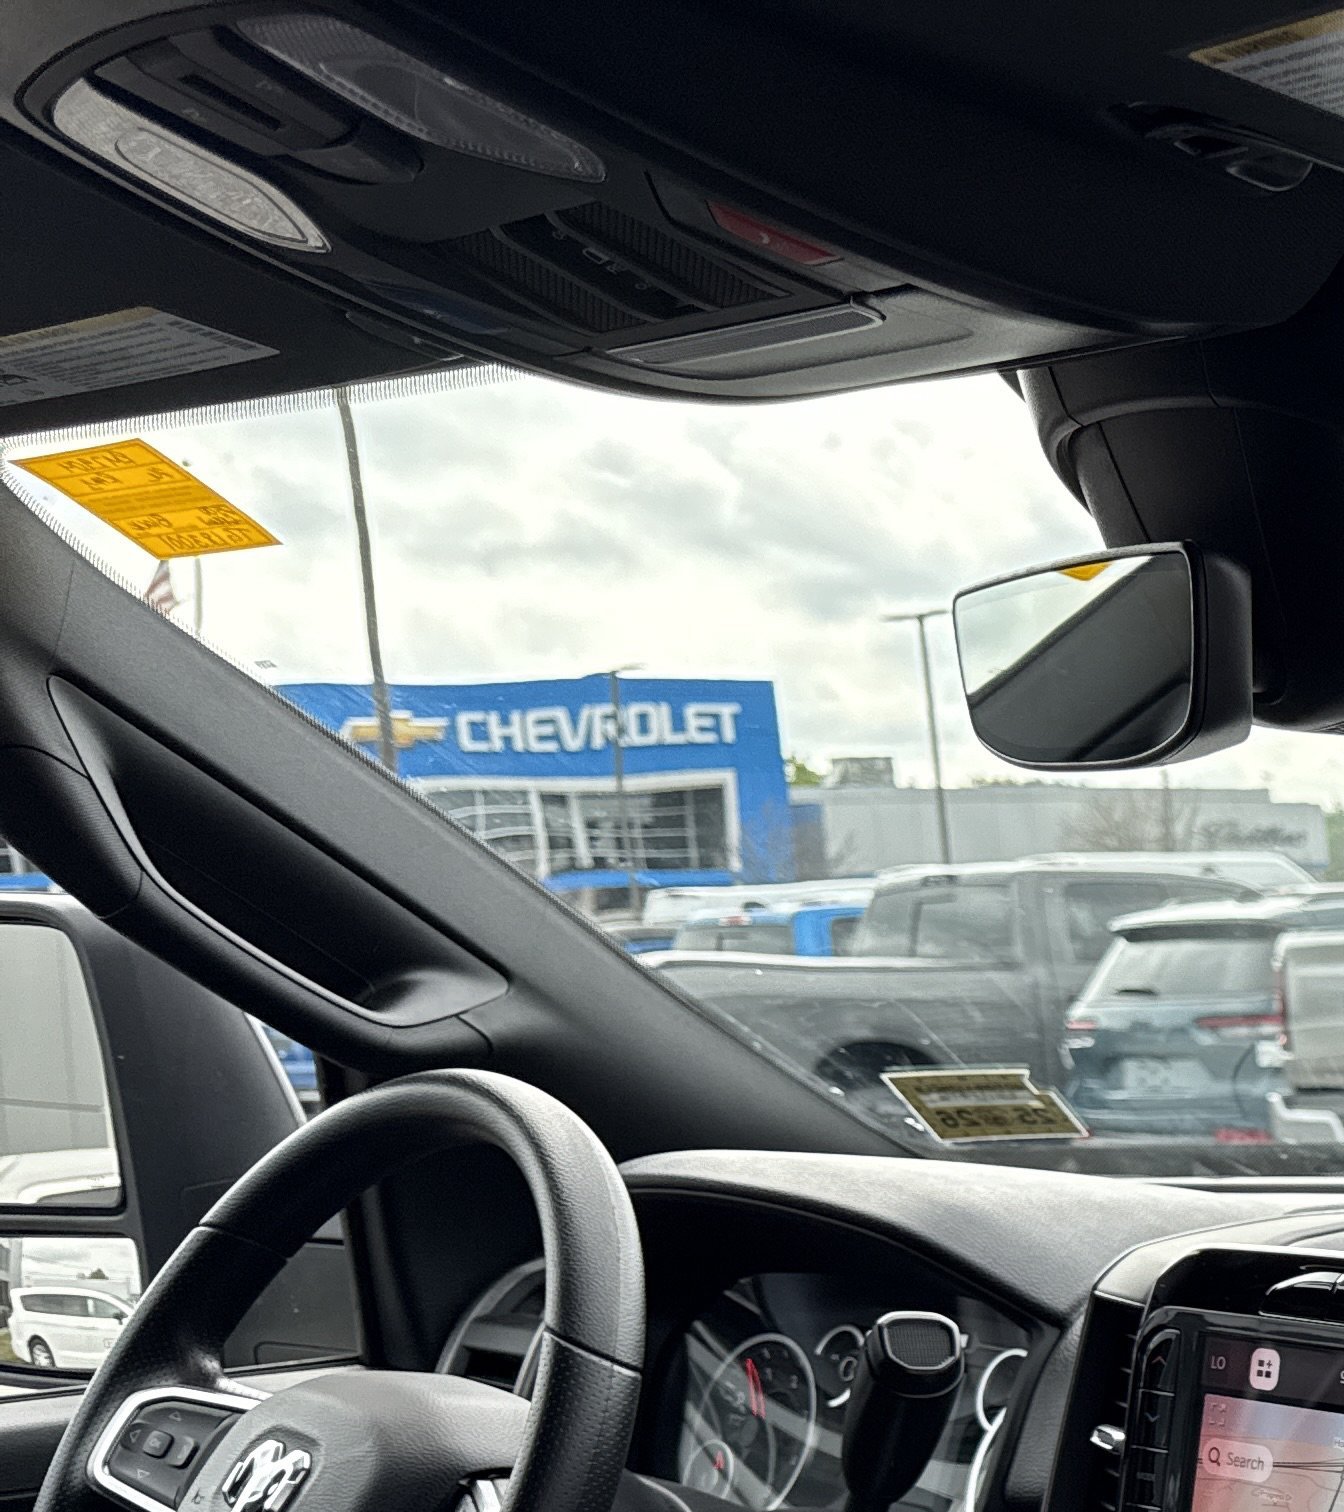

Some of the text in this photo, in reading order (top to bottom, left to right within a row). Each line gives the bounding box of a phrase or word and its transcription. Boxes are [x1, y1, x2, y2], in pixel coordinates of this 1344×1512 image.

[456, 701, 742, 754] CHEVROLET
[1211, 1356, 1227, 1370] LO
[1226, 1452, 1265, 1471] Search
